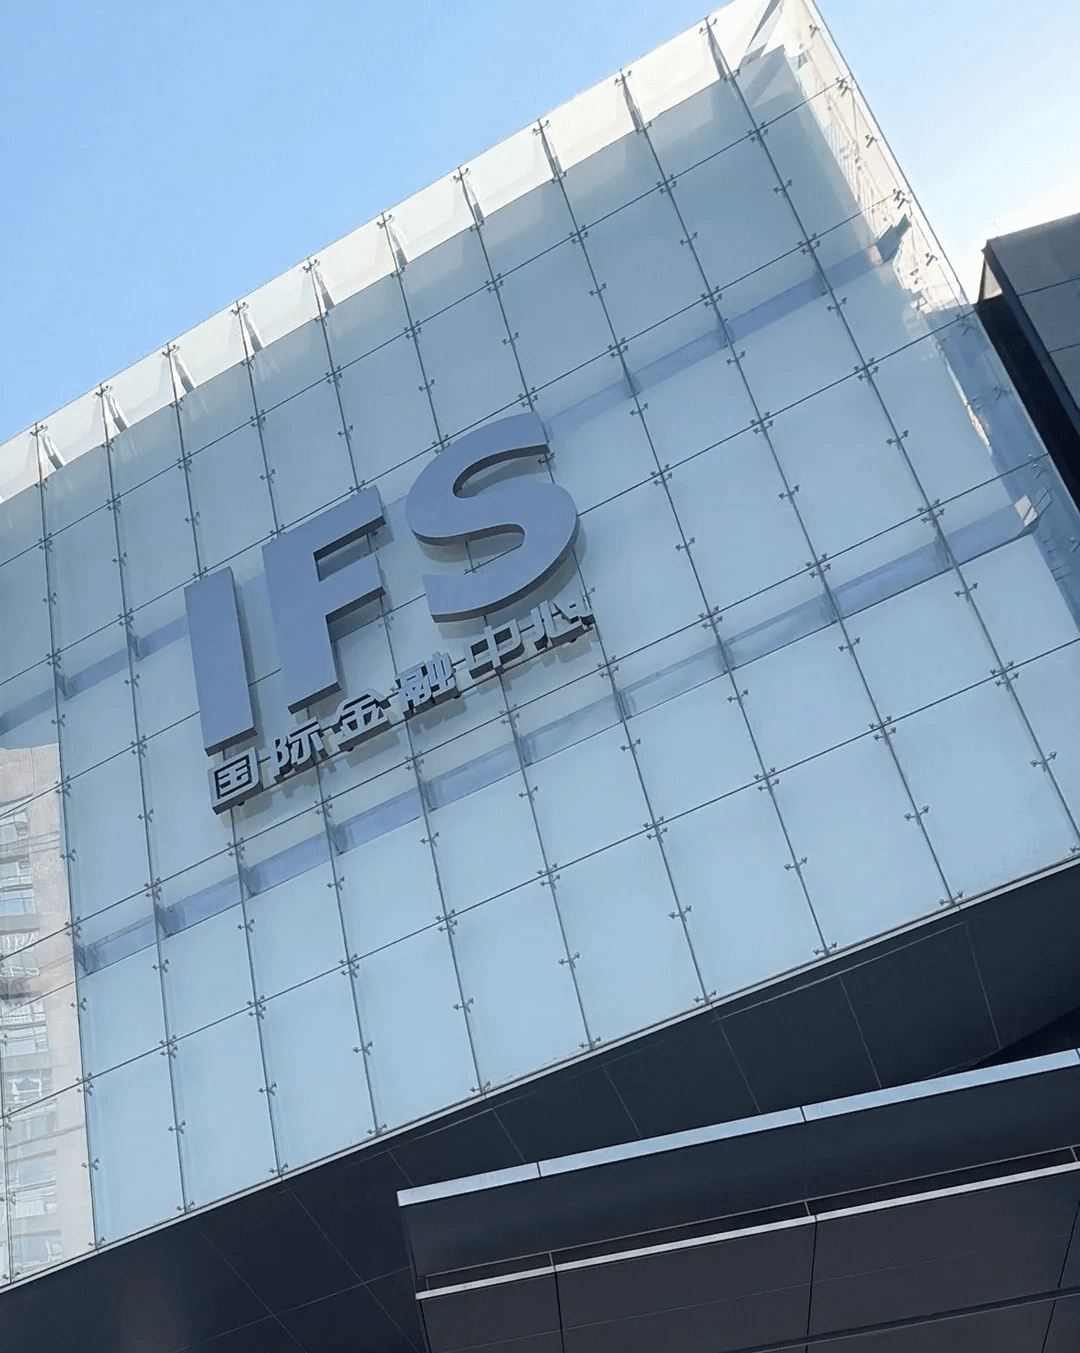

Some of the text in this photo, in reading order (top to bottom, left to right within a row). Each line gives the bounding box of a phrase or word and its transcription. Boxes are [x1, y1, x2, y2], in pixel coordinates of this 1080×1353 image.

[184, 412, 577, 756] IFS
[207, 588, 595, 815] 国际金融中心
